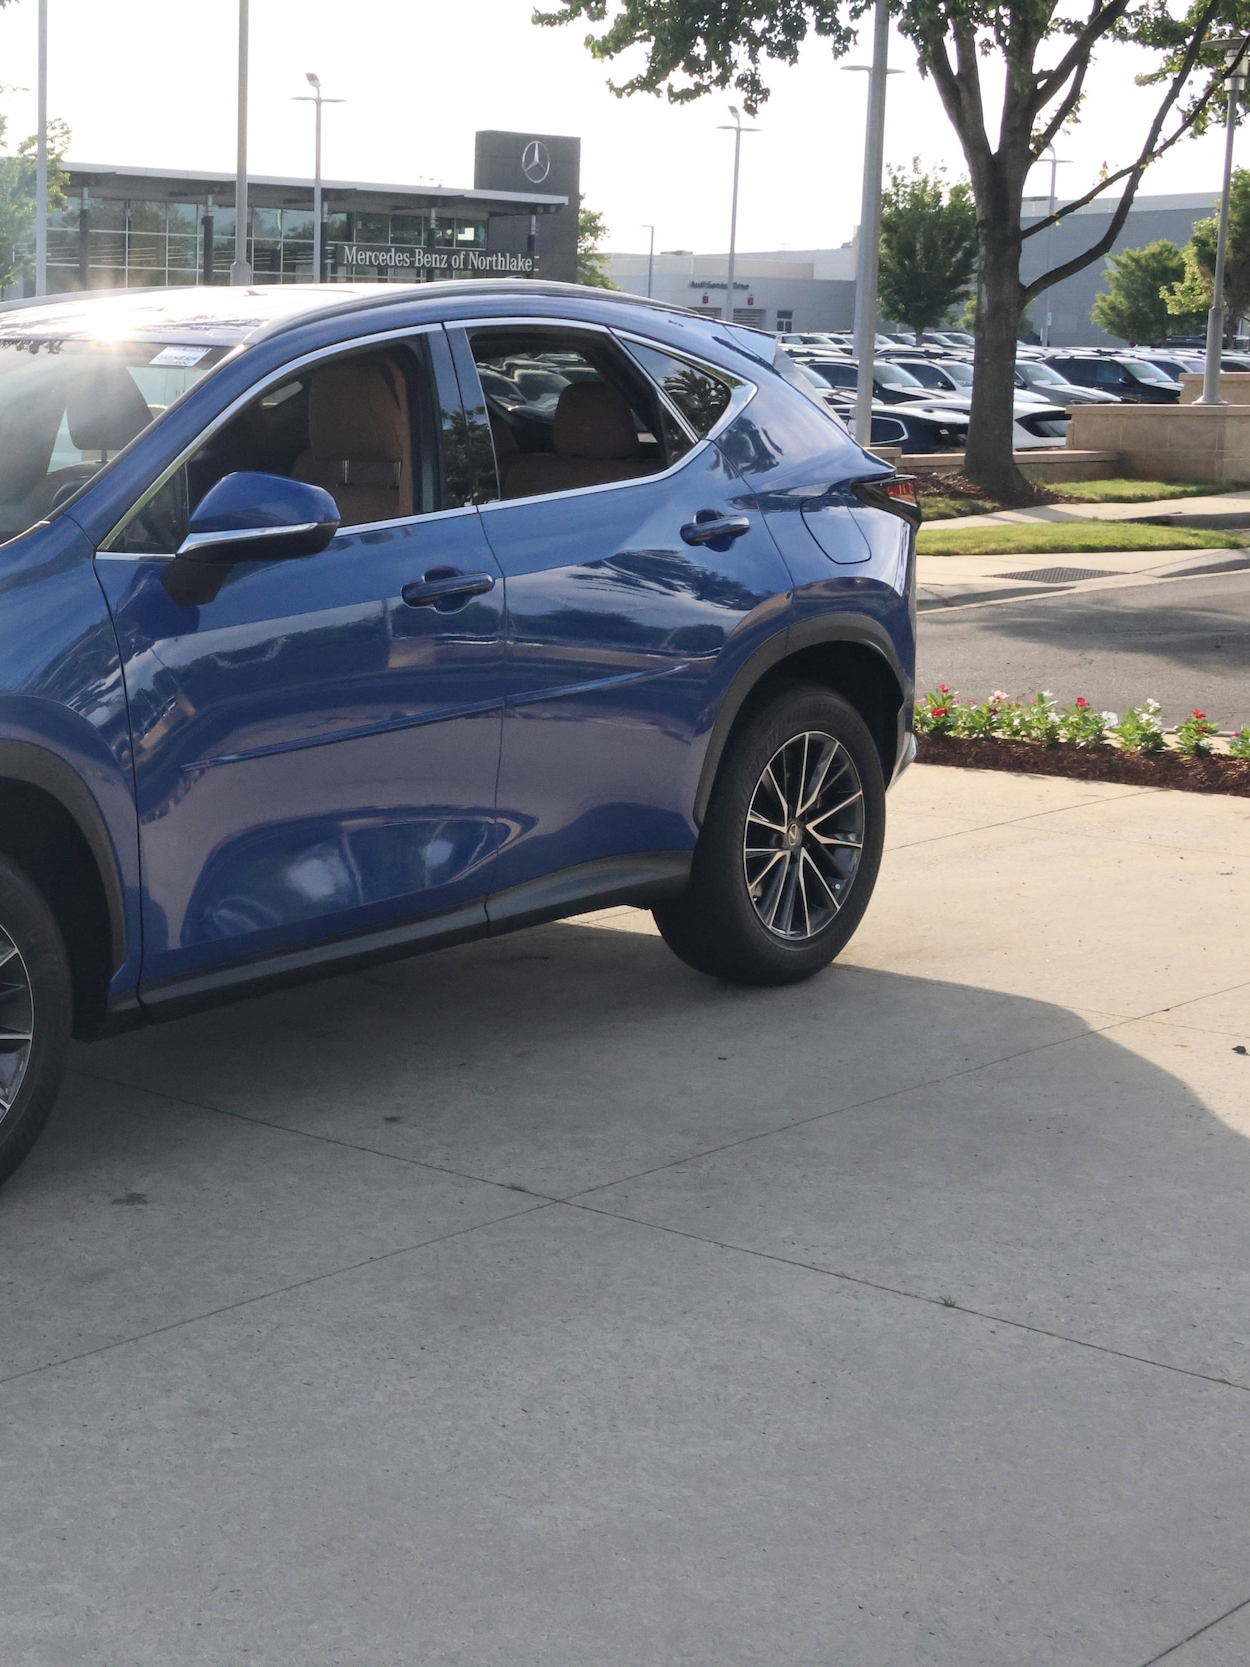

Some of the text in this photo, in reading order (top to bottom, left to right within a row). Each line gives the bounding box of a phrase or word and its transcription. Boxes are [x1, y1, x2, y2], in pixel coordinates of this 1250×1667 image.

[343, 245, 533, 272] Mercedes-Benz of Northlake
